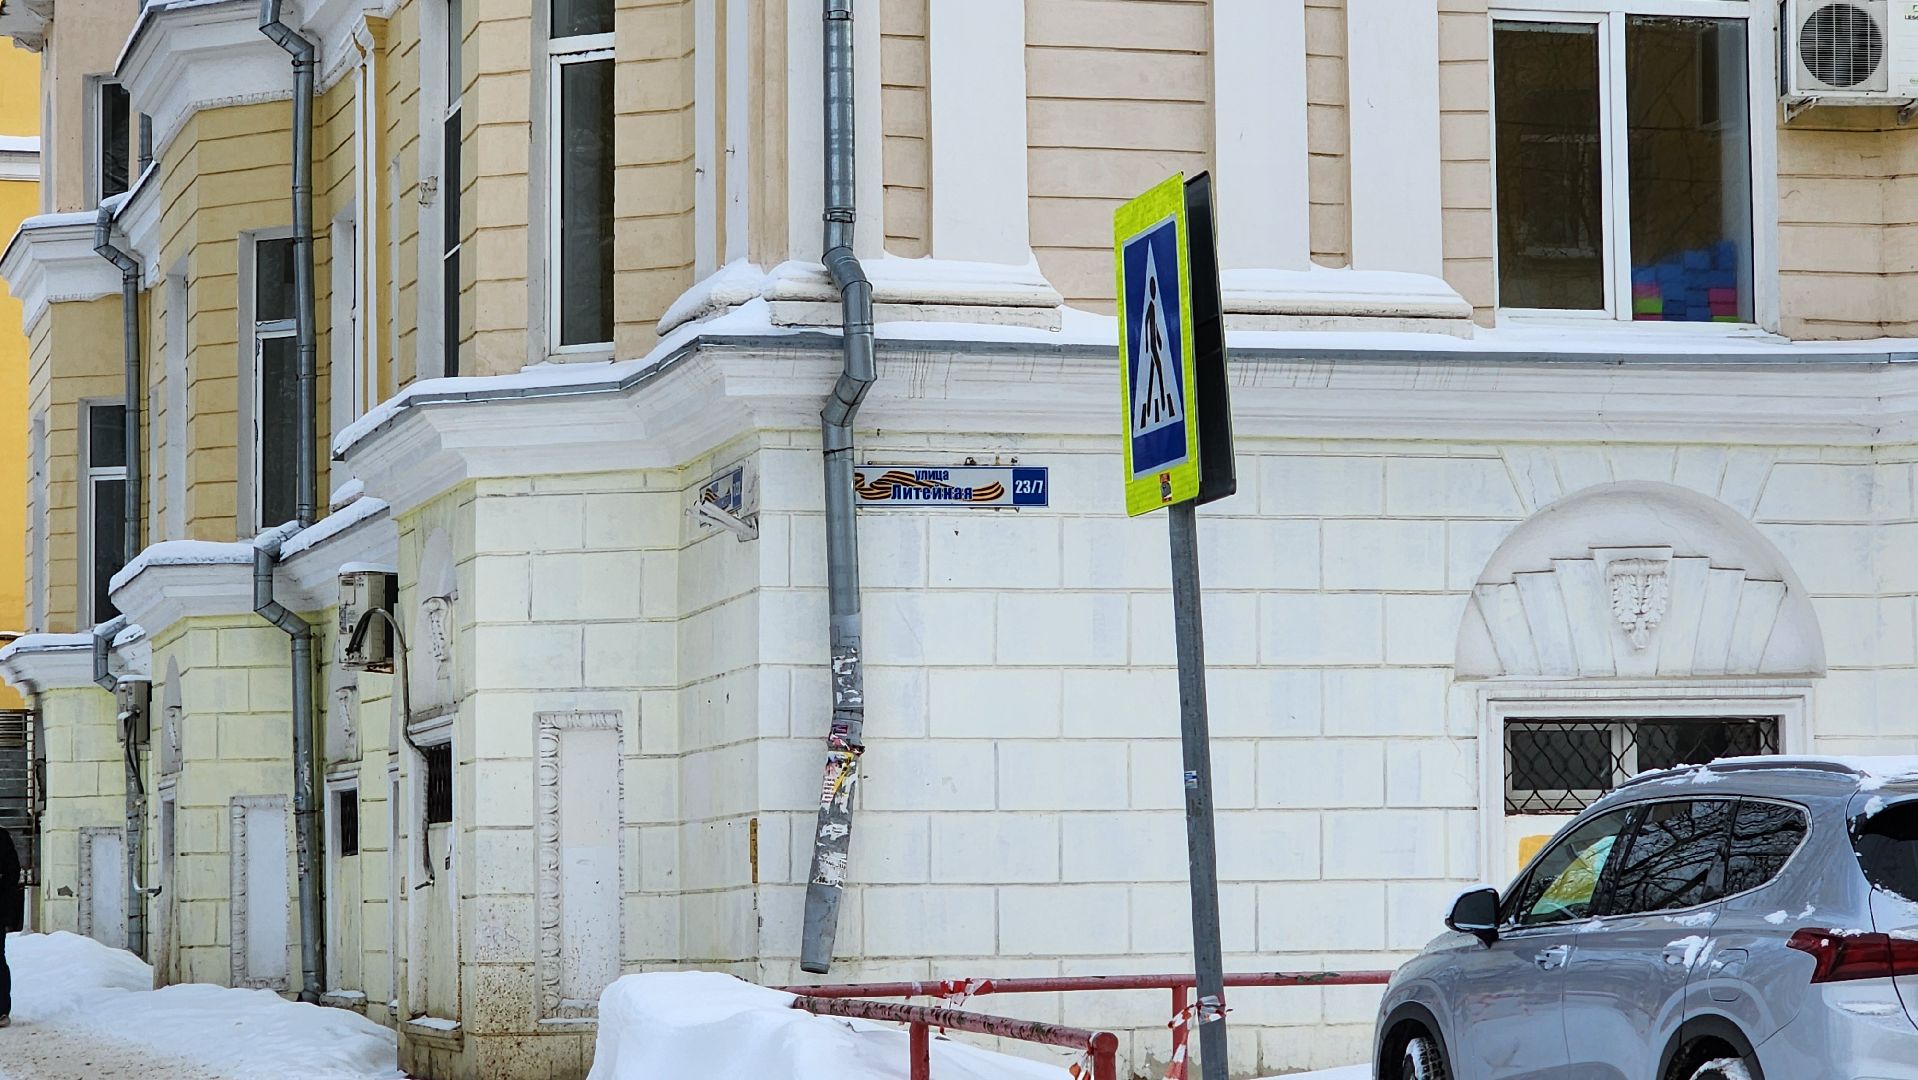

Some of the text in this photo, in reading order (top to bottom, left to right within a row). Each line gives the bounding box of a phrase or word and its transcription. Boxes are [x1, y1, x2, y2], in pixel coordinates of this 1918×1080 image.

[914, 469, 949, 481] улица
[891, 484, 973, 500] Литейная
[1015, 479, 1044, 494] 23/7
